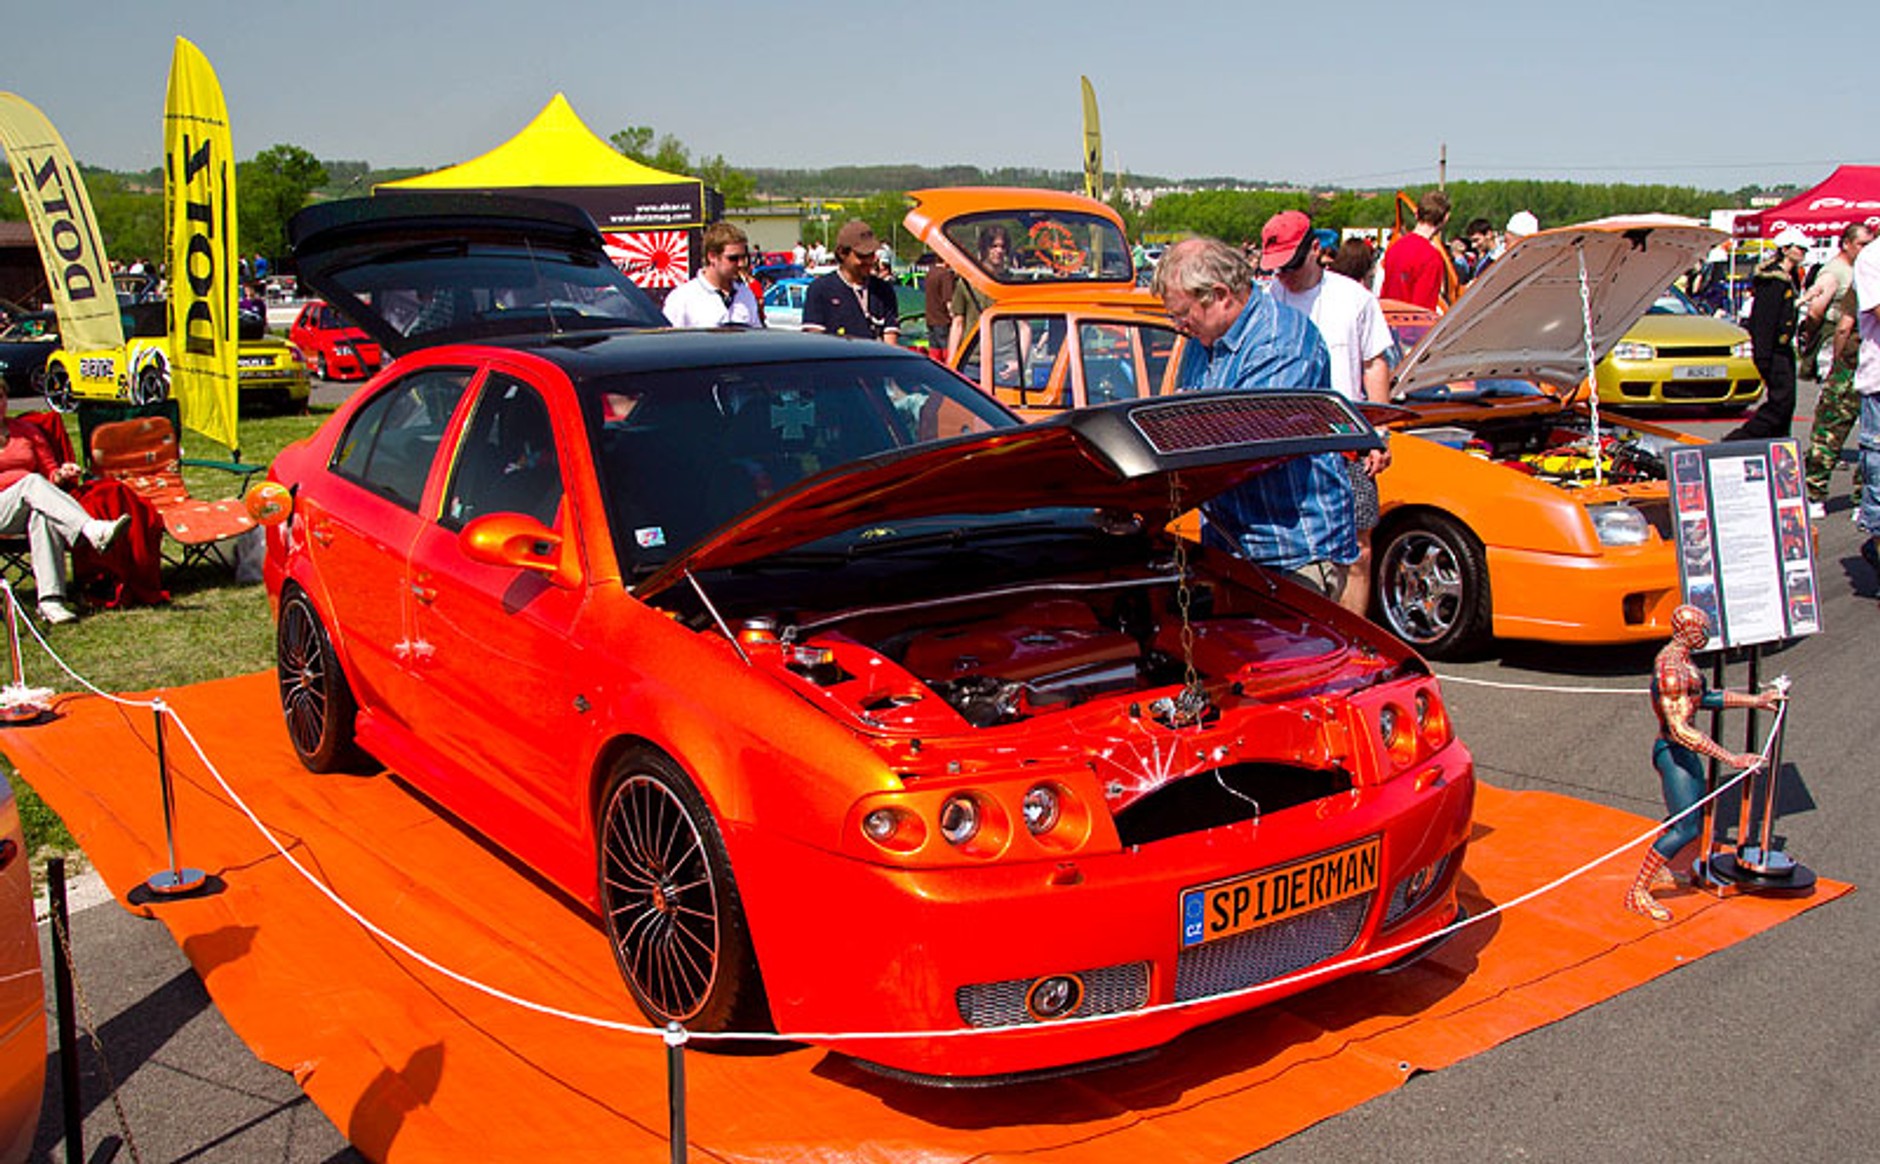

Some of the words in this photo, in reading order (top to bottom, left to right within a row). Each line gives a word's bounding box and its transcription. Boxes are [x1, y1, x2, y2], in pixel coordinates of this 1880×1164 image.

[1769, 219, 1850, 232] Pioneer
[1211, 846, 1376, 932] SPIDERMAN
[1186, 922, 1202, 937] CZ
